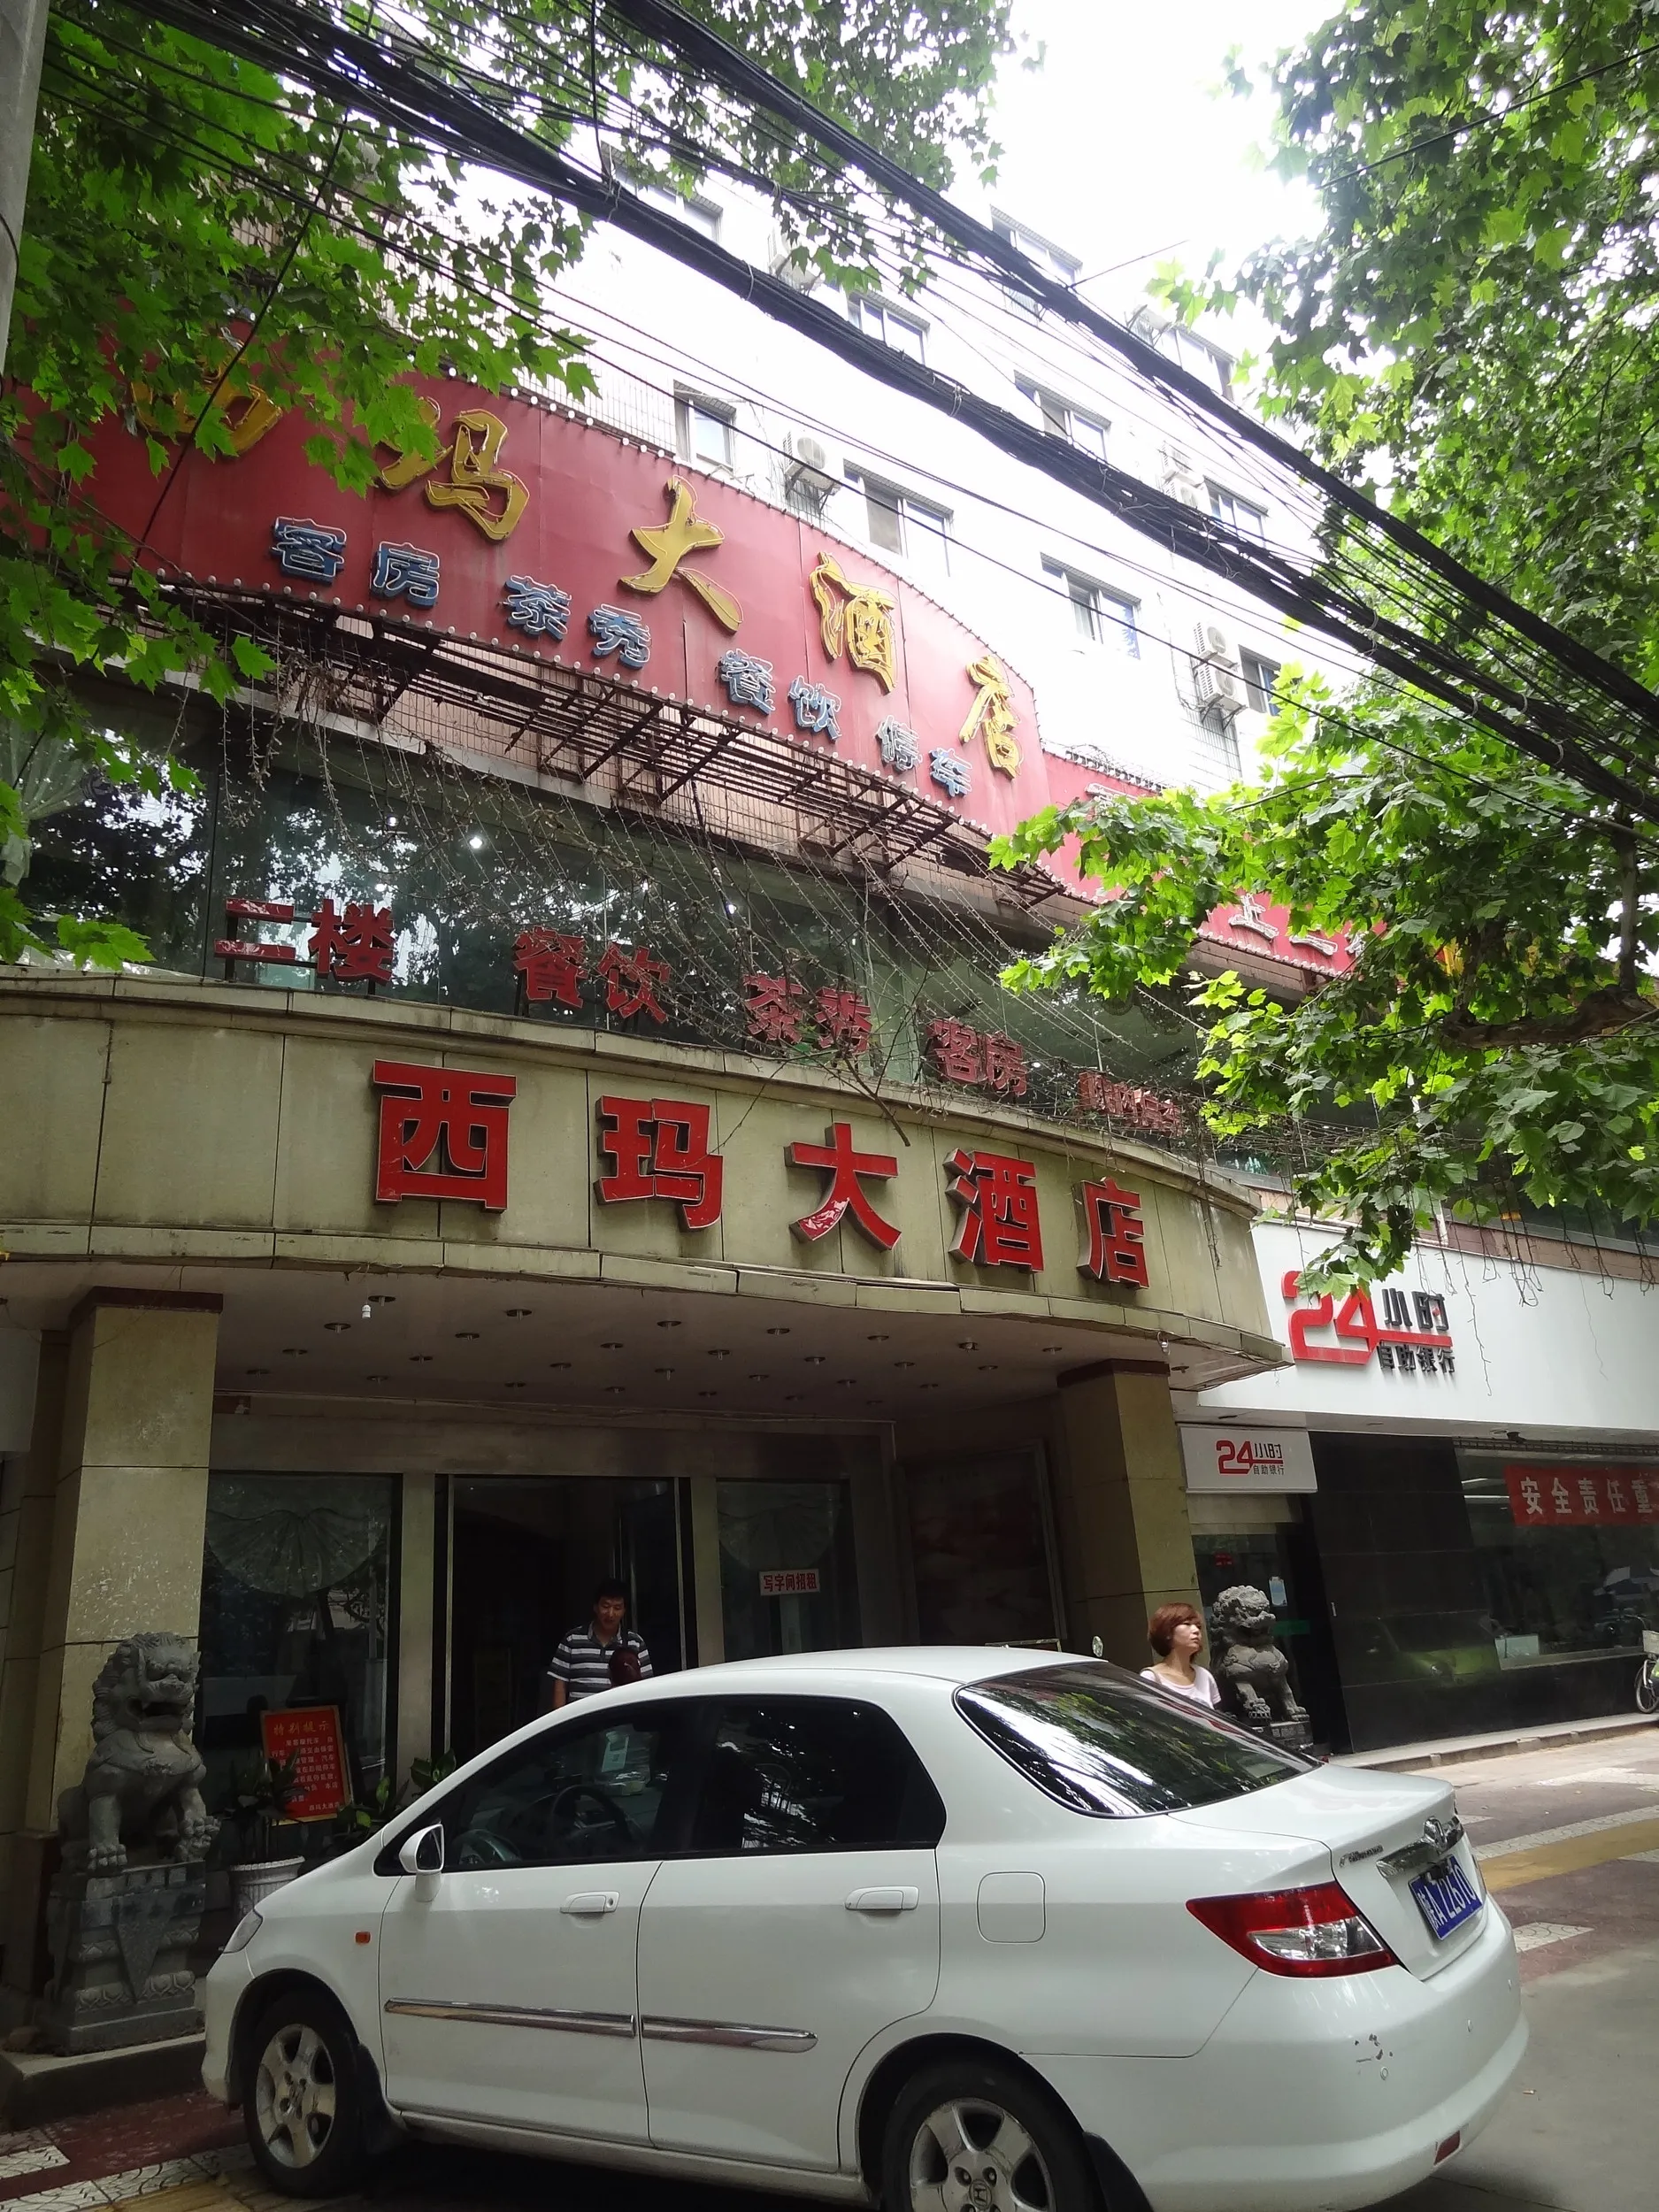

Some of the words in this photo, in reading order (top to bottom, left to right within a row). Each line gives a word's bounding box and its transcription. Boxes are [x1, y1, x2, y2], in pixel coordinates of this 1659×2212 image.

[270, 516, 441, 609] 客房
[718, 648, 842, 743] 餐饮
[214, 897, 396, 986] 二楼
[512, 926, 671, 1024] 餐饮
[742, 974, 873, 1056] 茶秀
[926, 1016, 1028, 1096] 客房
[373, 1059, 1149, 1290] 西玛大酒店
[1377, 1340, 1455, 1373] 自助银行
[1253, 1464, 1285, 1476] 自助银行
[1520, 1476, 1653, 1515] 安全责任重
[764, 1572, 818, 1592] 写字间招租
[273, 1720, 328, 1736] 特别提示
